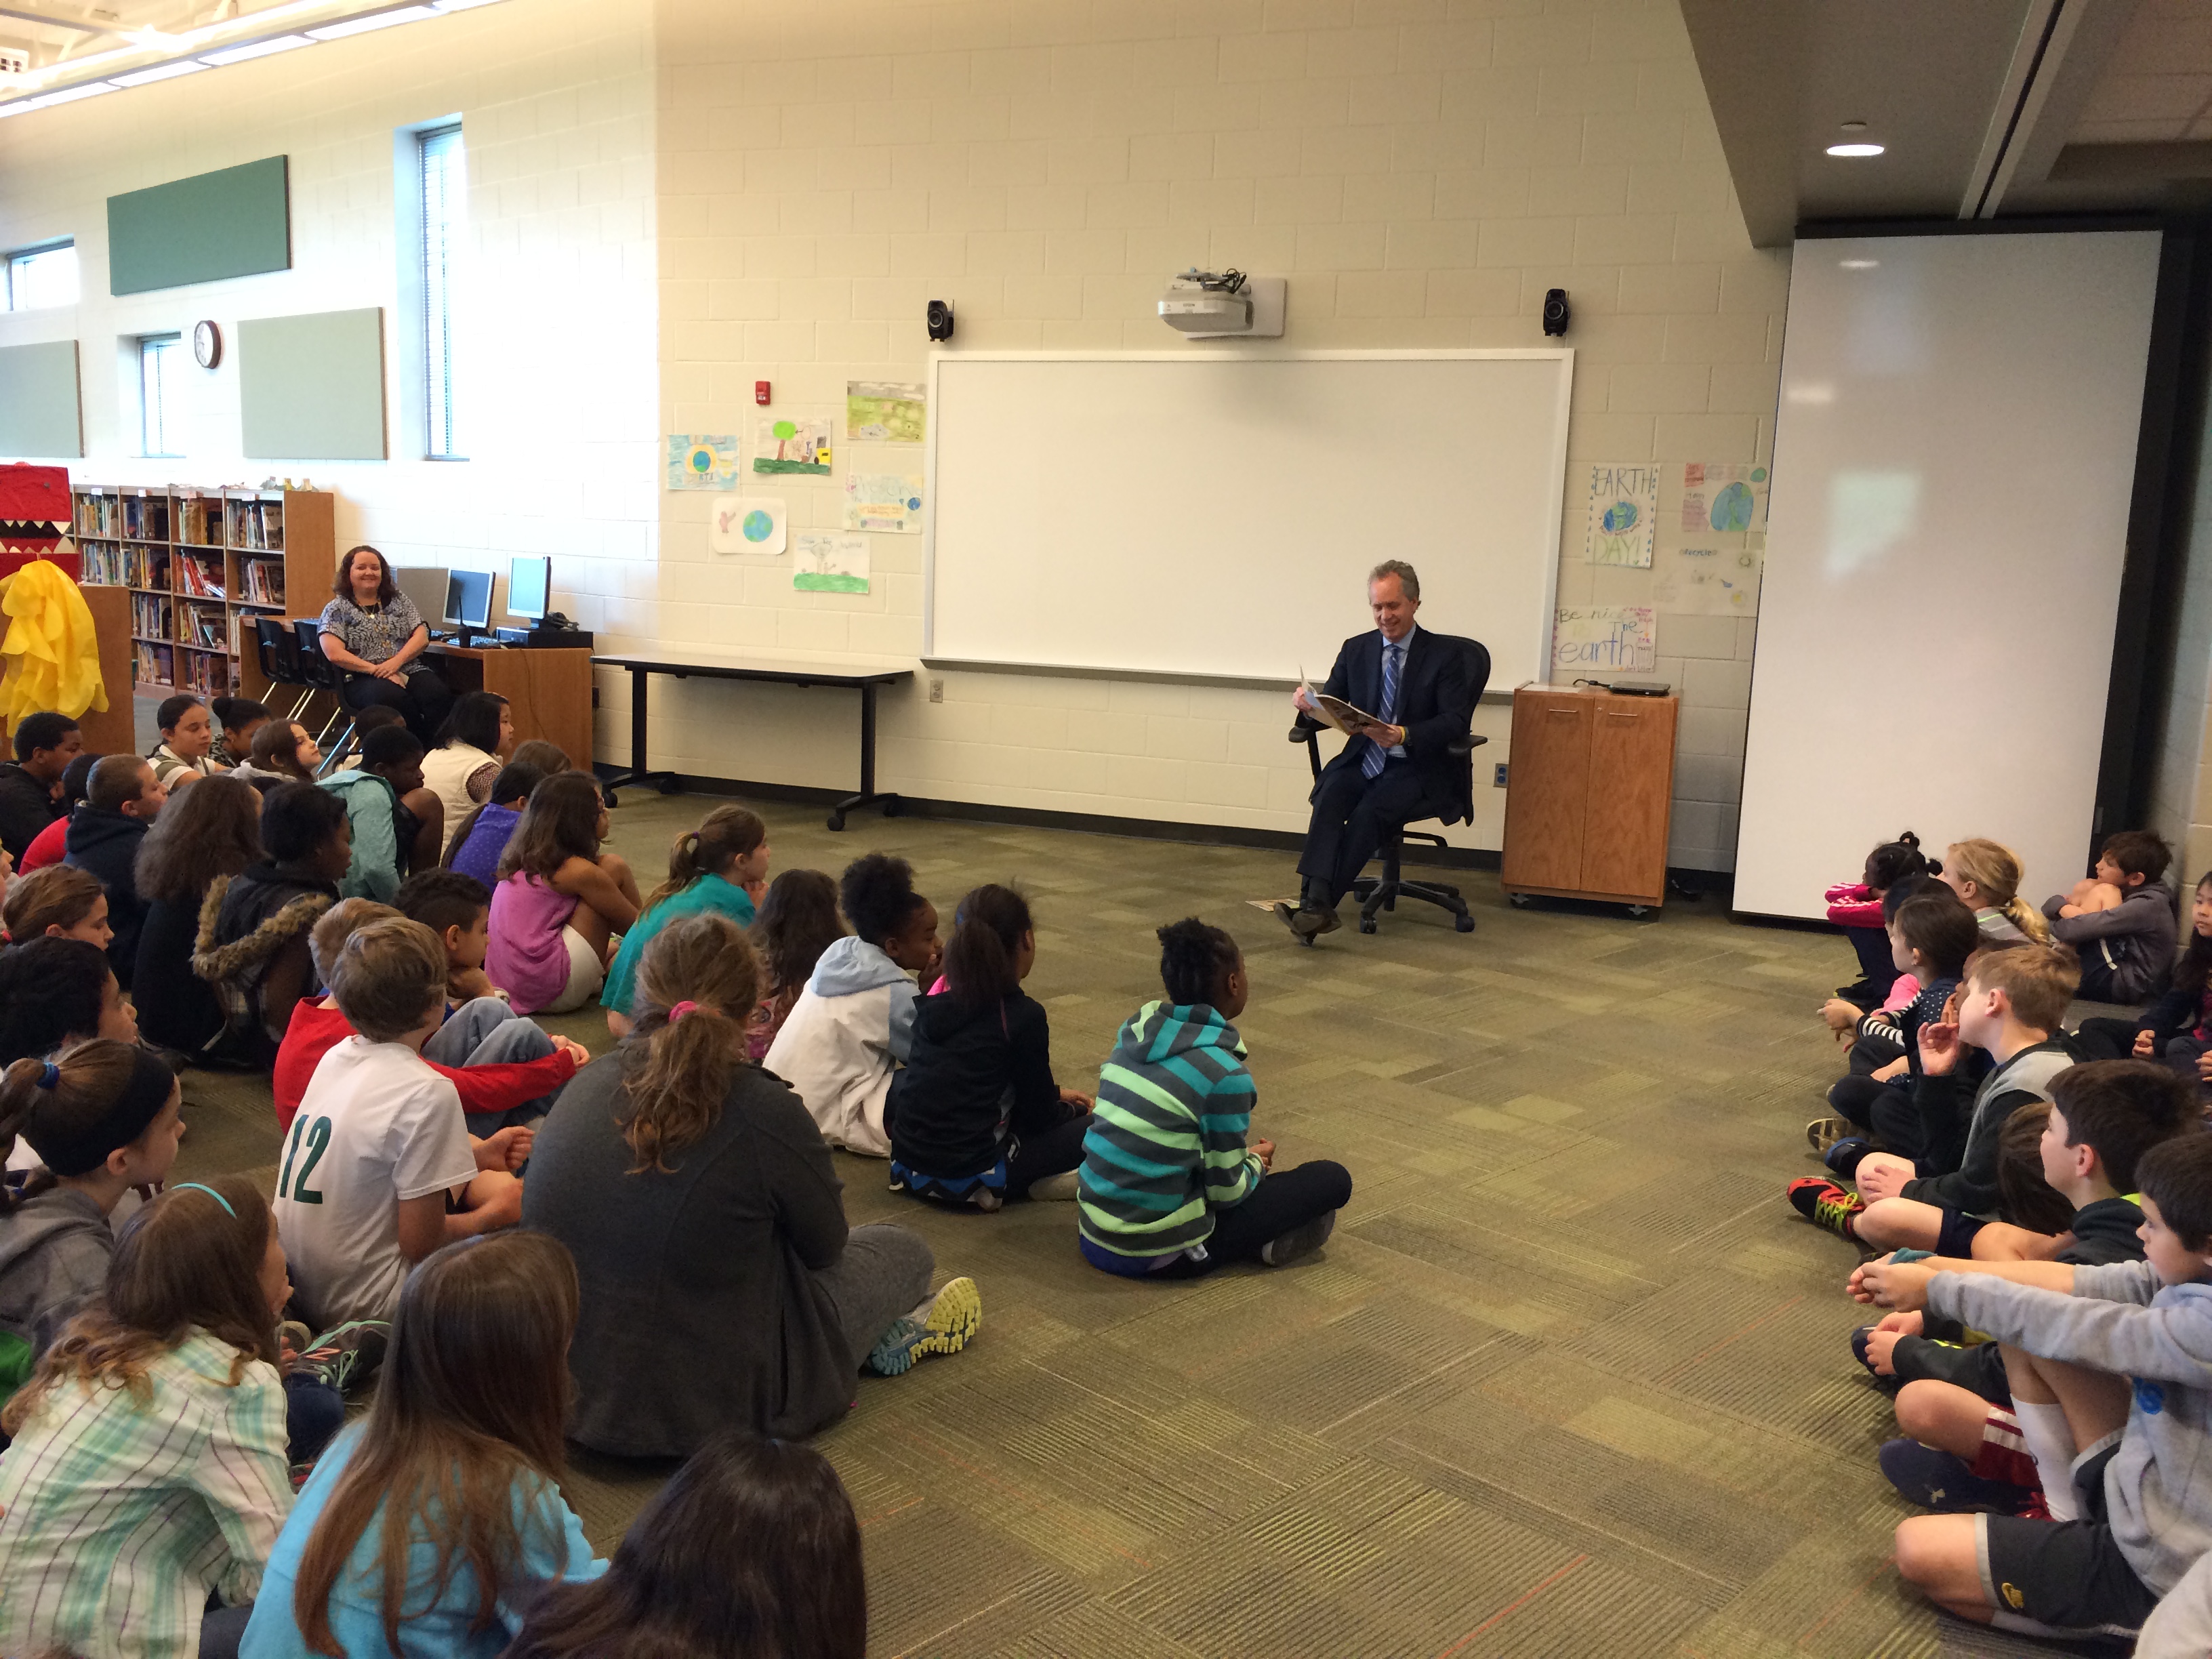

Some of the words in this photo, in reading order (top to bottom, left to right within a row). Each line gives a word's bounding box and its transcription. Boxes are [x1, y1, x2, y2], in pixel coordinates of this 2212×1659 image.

[1594, 467, 1654, 496] EARTH
[1593, 535, 1641, 565] DAY!
[1559, 609, 1582, 623] Be
[1559, 632, 1634, 665] earth
[279, 1114, 332, 1204] 12
